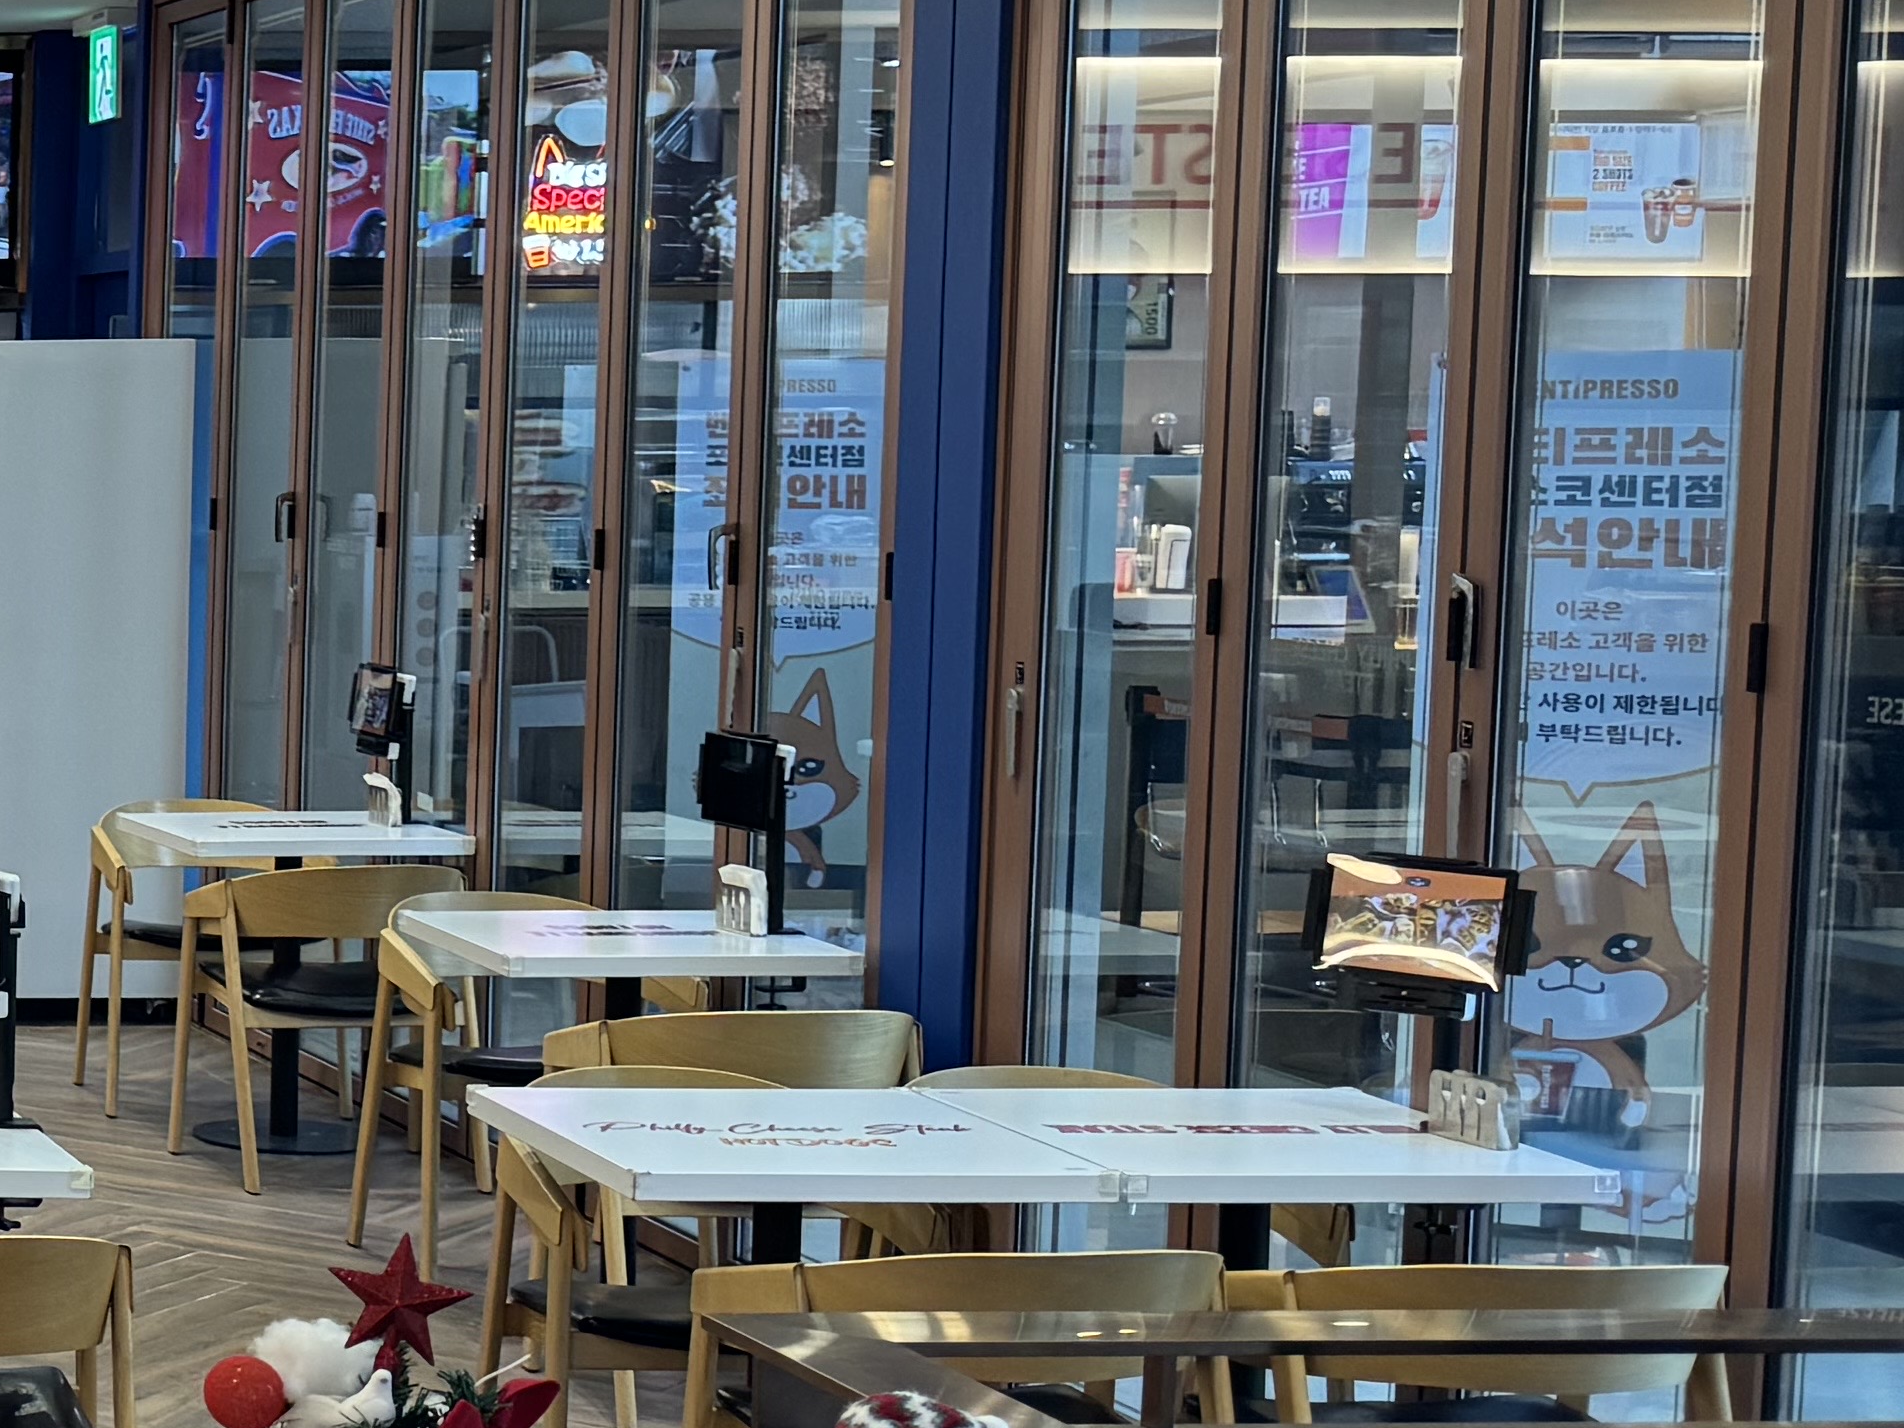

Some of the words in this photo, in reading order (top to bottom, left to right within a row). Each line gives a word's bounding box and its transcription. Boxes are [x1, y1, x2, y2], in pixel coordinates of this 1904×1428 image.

[533, 184, 606, 212] Speci
[1534, 427, 1726, 466] 티프레소
[1556, 600, 1624, 621] 이곳은
[1588, 632, 1657, 653] 고객을
[1663, 633, 1710, 654] 위한
[1538, 692, 1605, 714] 사용이
[1536, 724, 1683, 747] 부탁드립니다.
